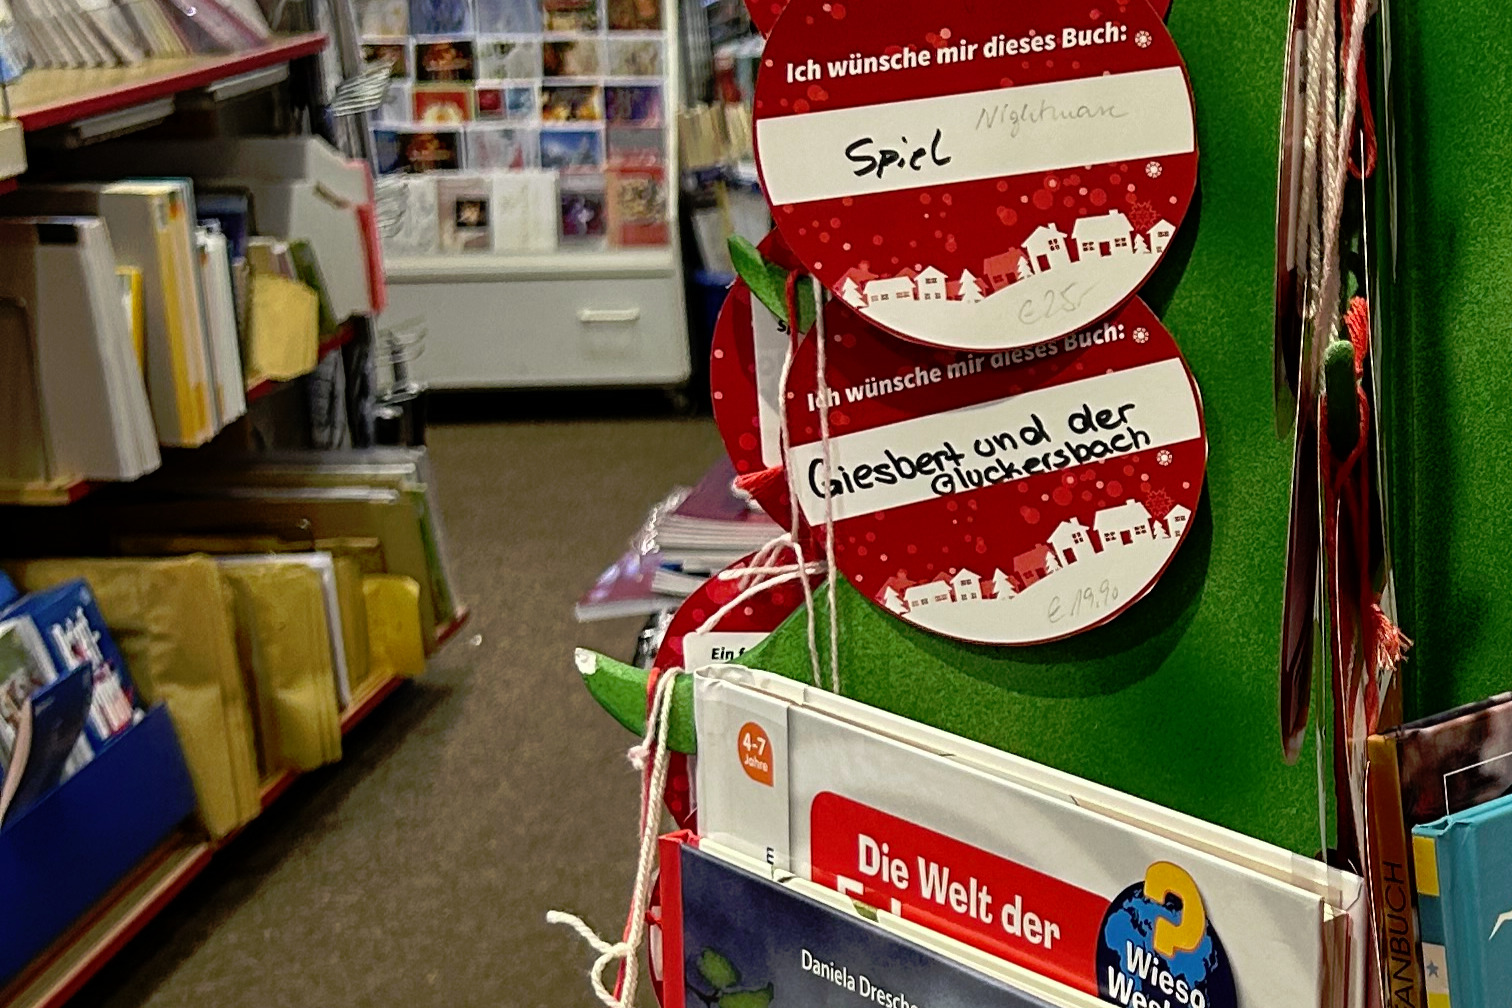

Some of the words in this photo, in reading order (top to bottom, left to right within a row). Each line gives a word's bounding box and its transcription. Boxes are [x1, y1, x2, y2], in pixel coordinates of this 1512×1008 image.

[786, 61, 822, 83] Ich
[828, 47, 931, 78] wünsche
[936, 40, 978, 65] mir
[983, 30, 1057, 59] dieses
[1061, 22, 1128, 49] Buch:
[845, 129, 951, 178] Spiel
[845, 366, 942, 403] wünsche
[946, 353, 985, 380] mir
[1063, 323, 1125, 352] Buch:
[973, 414, 1051, 458] und
[1068, 403, 1136, 435] der
[711, 647, 735, 661] Ein
[742, 732, 767, 755] 4-7
[744, 755, 769, 773] Jahre
[858, 833, 909, 889] Die
[917, 855, 993, 925] Welt
[1002, 894, 1062, 950] der
[801, 948, 856, 992] Daniela
[1126, 940, 1206, 1008] Wieso
